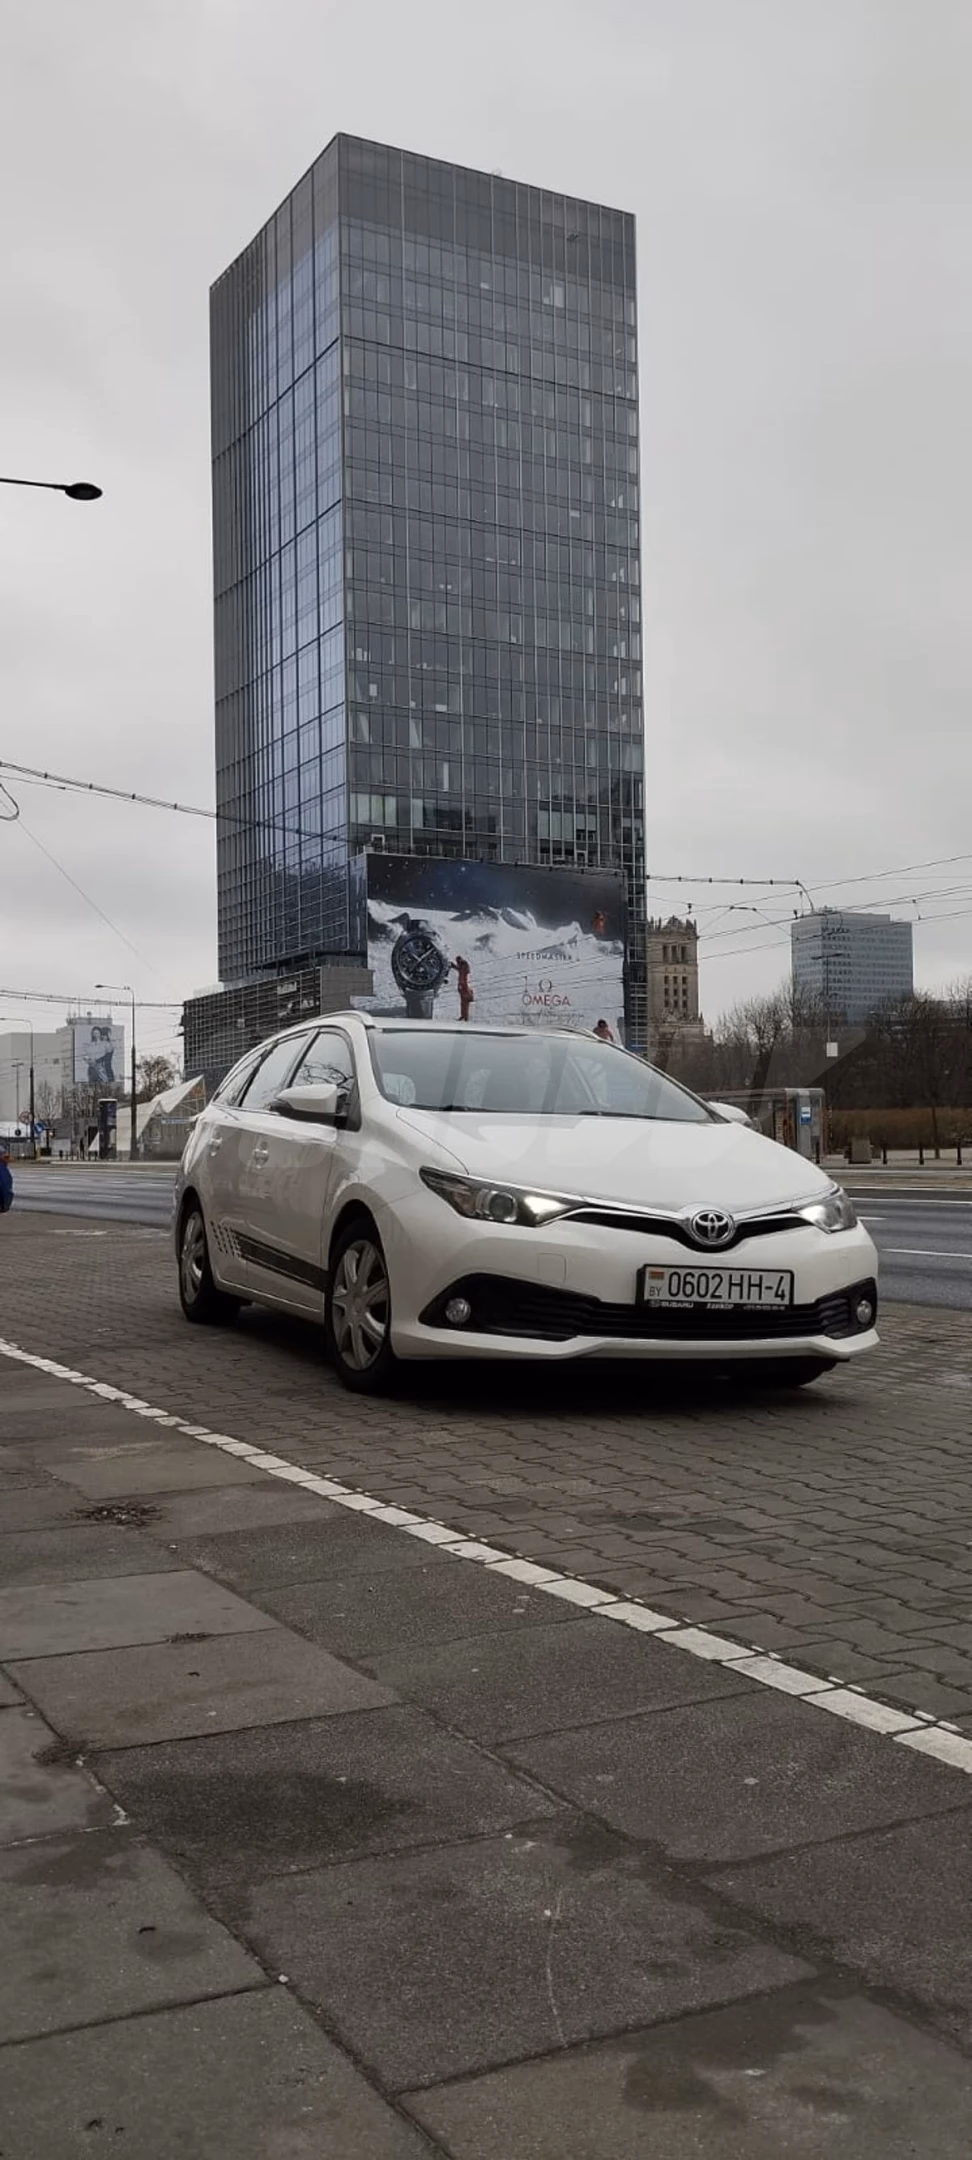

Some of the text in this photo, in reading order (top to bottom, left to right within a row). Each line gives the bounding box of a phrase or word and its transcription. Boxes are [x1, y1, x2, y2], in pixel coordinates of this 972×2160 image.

[522, 993, 571, 1007] OMEGA
[649, 1271, 786, 1302] BY 0602 HH-4
